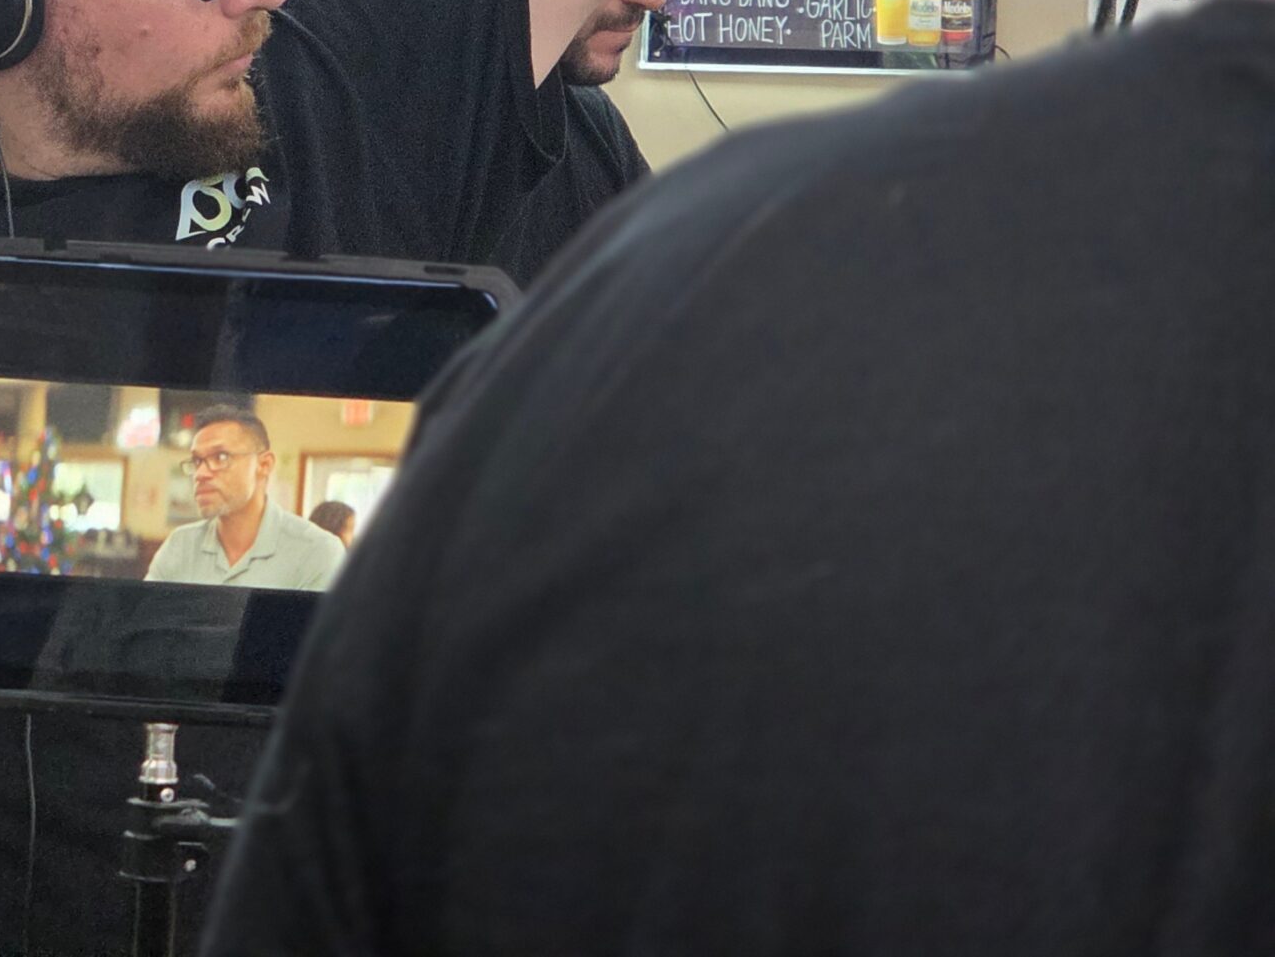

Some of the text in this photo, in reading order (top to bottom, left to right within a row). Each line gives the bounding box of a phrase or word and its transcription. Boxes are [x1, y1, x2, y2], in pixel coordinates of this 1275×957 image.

[667, 12, 872, 49] HOT HONEY PARM
